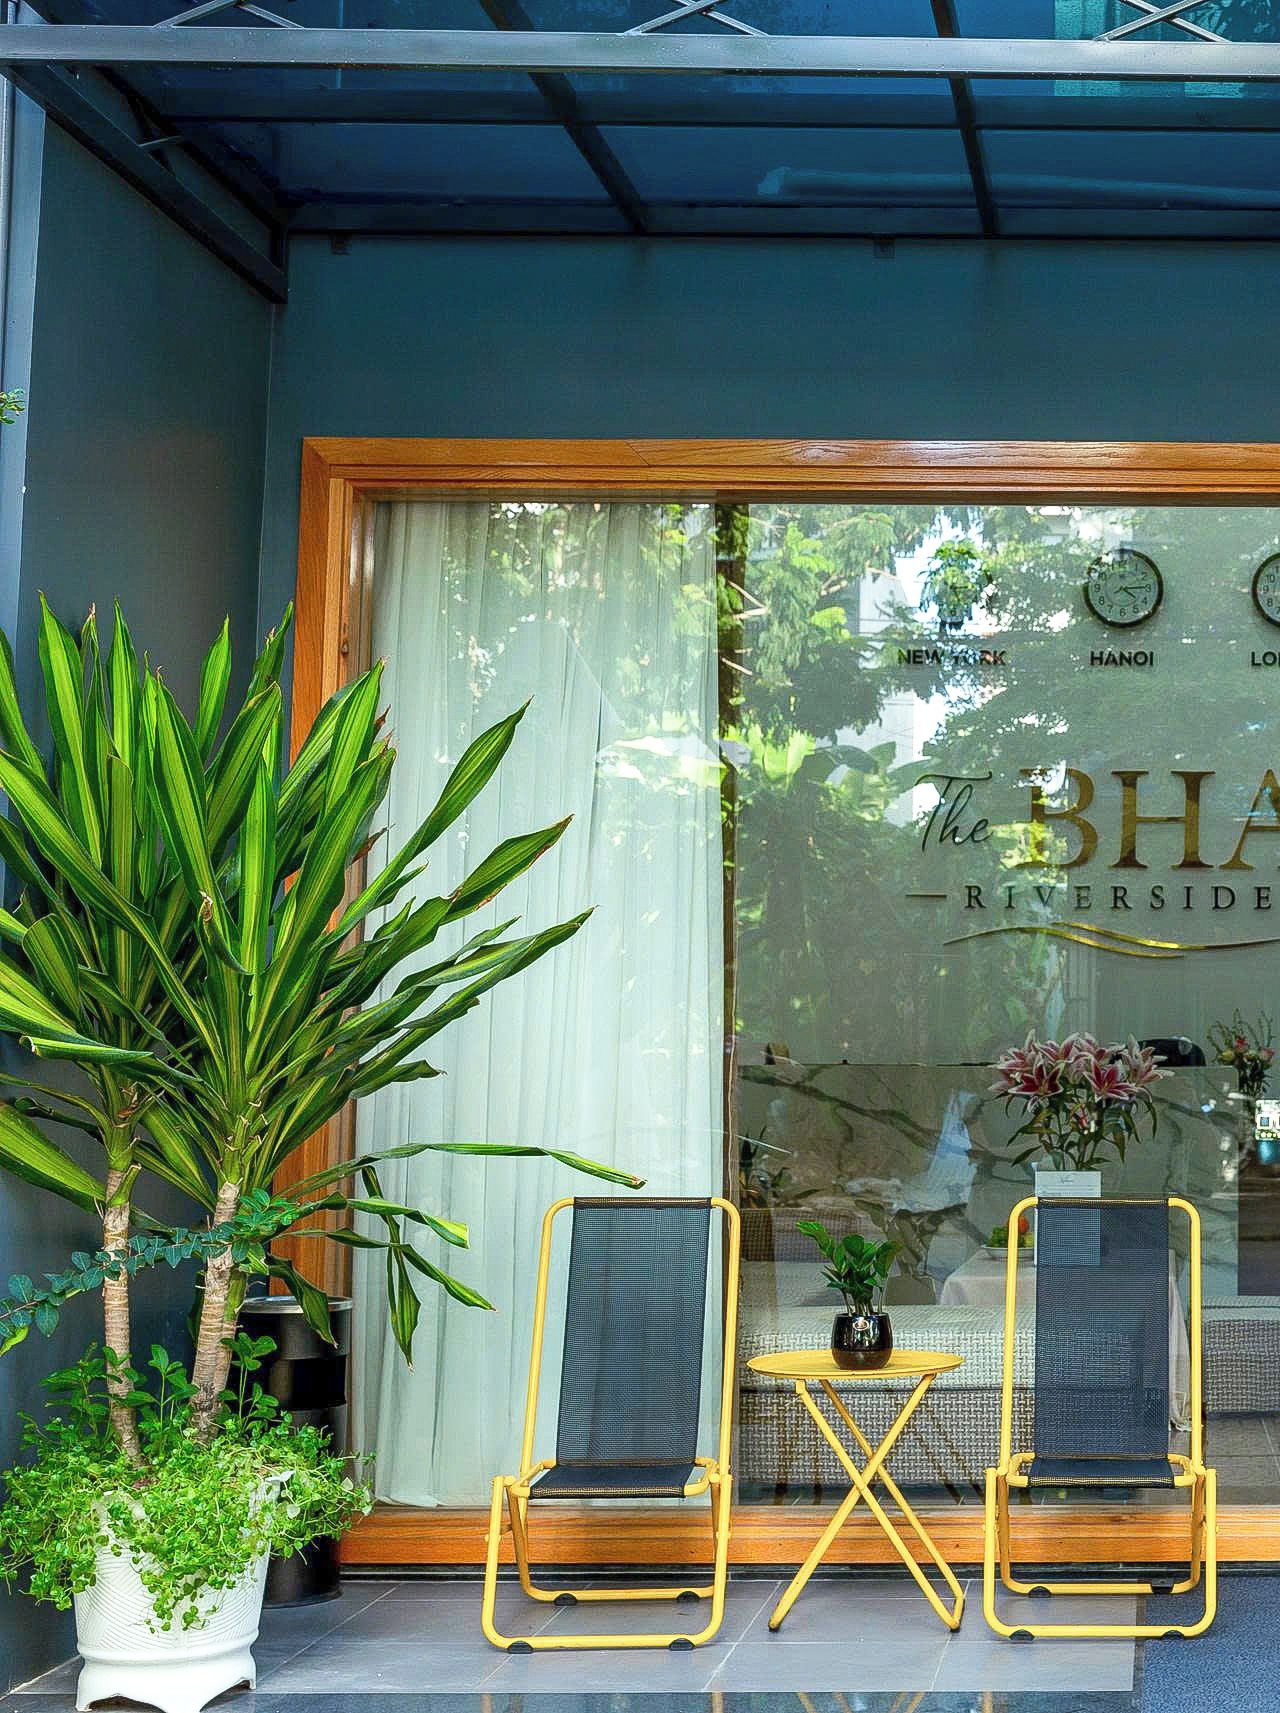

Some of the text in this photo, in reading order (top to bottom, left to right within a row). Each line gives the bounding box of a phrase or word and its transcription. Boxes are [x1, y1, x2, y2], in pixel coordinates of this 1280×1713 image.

[898, 648, 945, 665] NEW
[1090, 651, 1154, 666] HANOI
[915, 771, 993, 852] The
[965, 885, 1272, 910] RIVERSIDE
